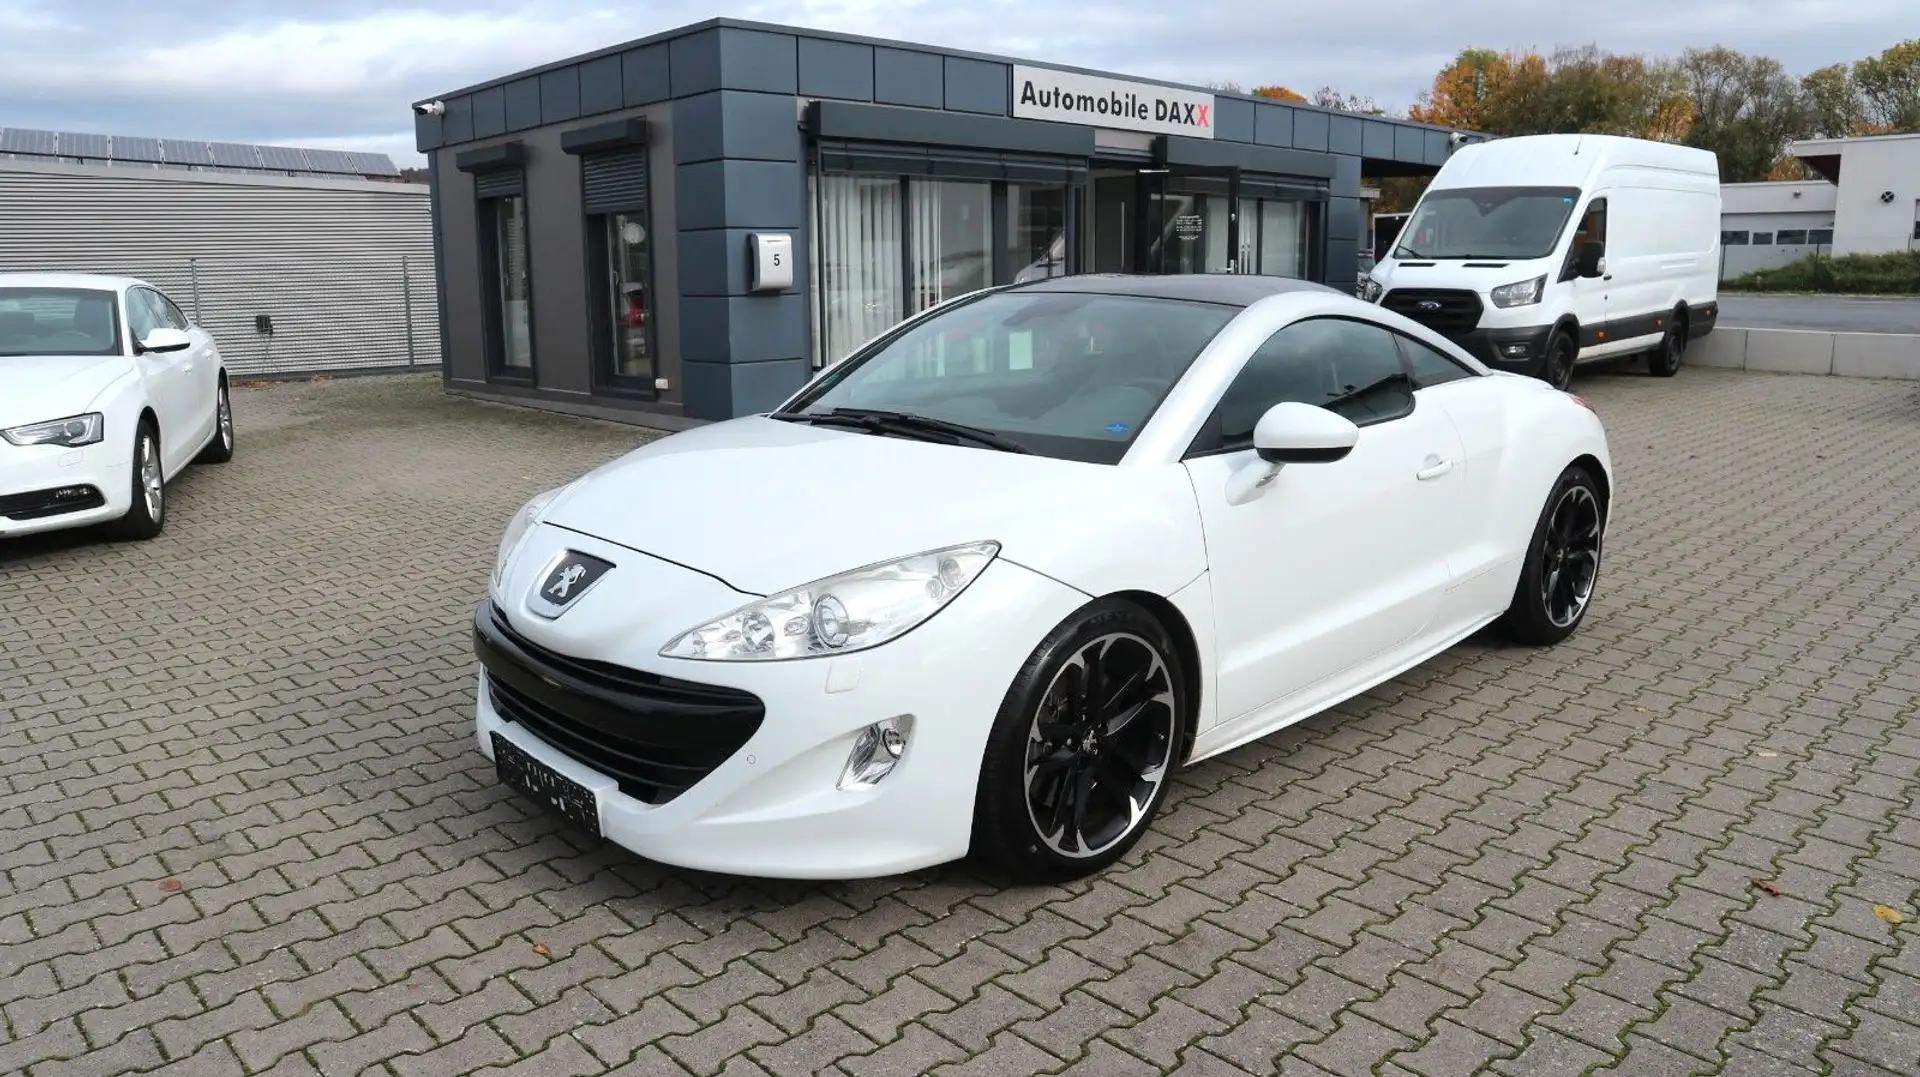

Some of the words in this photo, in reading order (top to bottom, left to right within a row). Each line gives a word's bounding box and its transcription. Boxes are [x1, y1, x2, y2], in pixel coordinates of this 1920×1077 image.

[1020, 80, 1149, 120] Automobile
[1155, 98, 1209, 128] DAXX
[773, 253, 780, 267] 5
